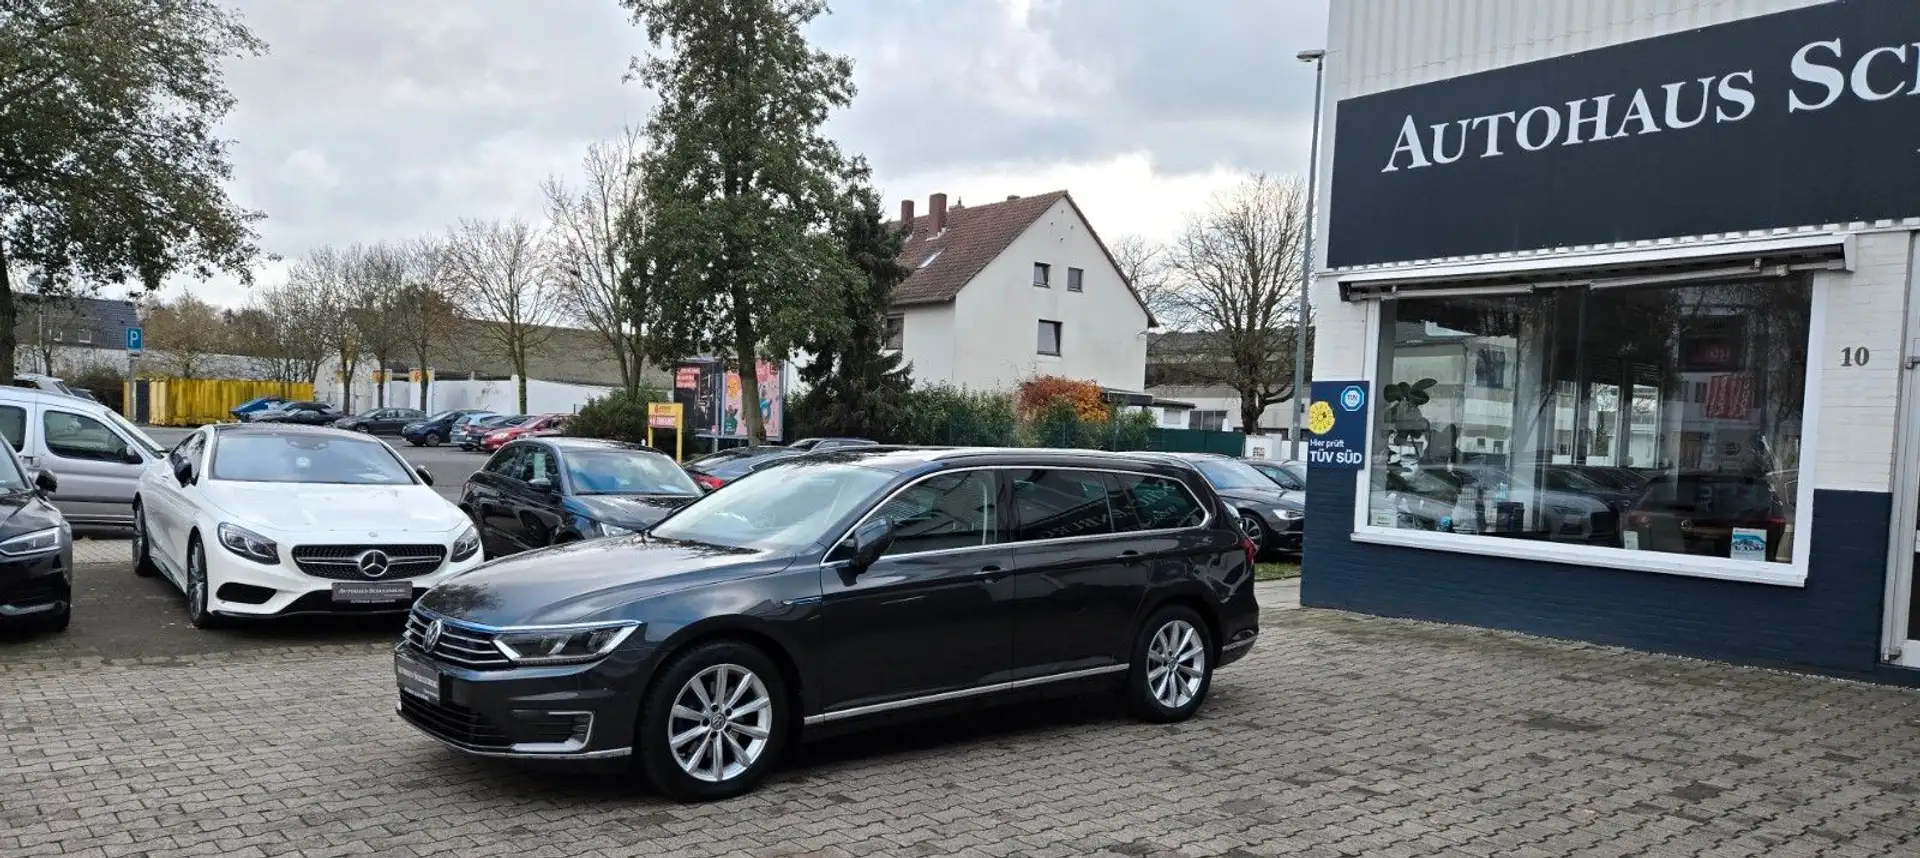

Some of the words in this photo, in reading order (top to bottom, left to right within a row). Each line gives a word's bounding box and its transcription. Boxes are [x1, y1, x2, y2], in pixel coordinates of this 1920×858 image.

[1381, 69, 1755, 173] AUTOHAUS
[1788, 37, 1920, 113] SC
[130, 330, 139, 347] P
[1840, 346, 1870, 367] 10
[1310, 438, 1325, 447] Hier
[1326, 439, 1345, 449] prüft
[1309, 448, 1334, 463] TÜV
[1336, 449, 1362, 464] SÜD
